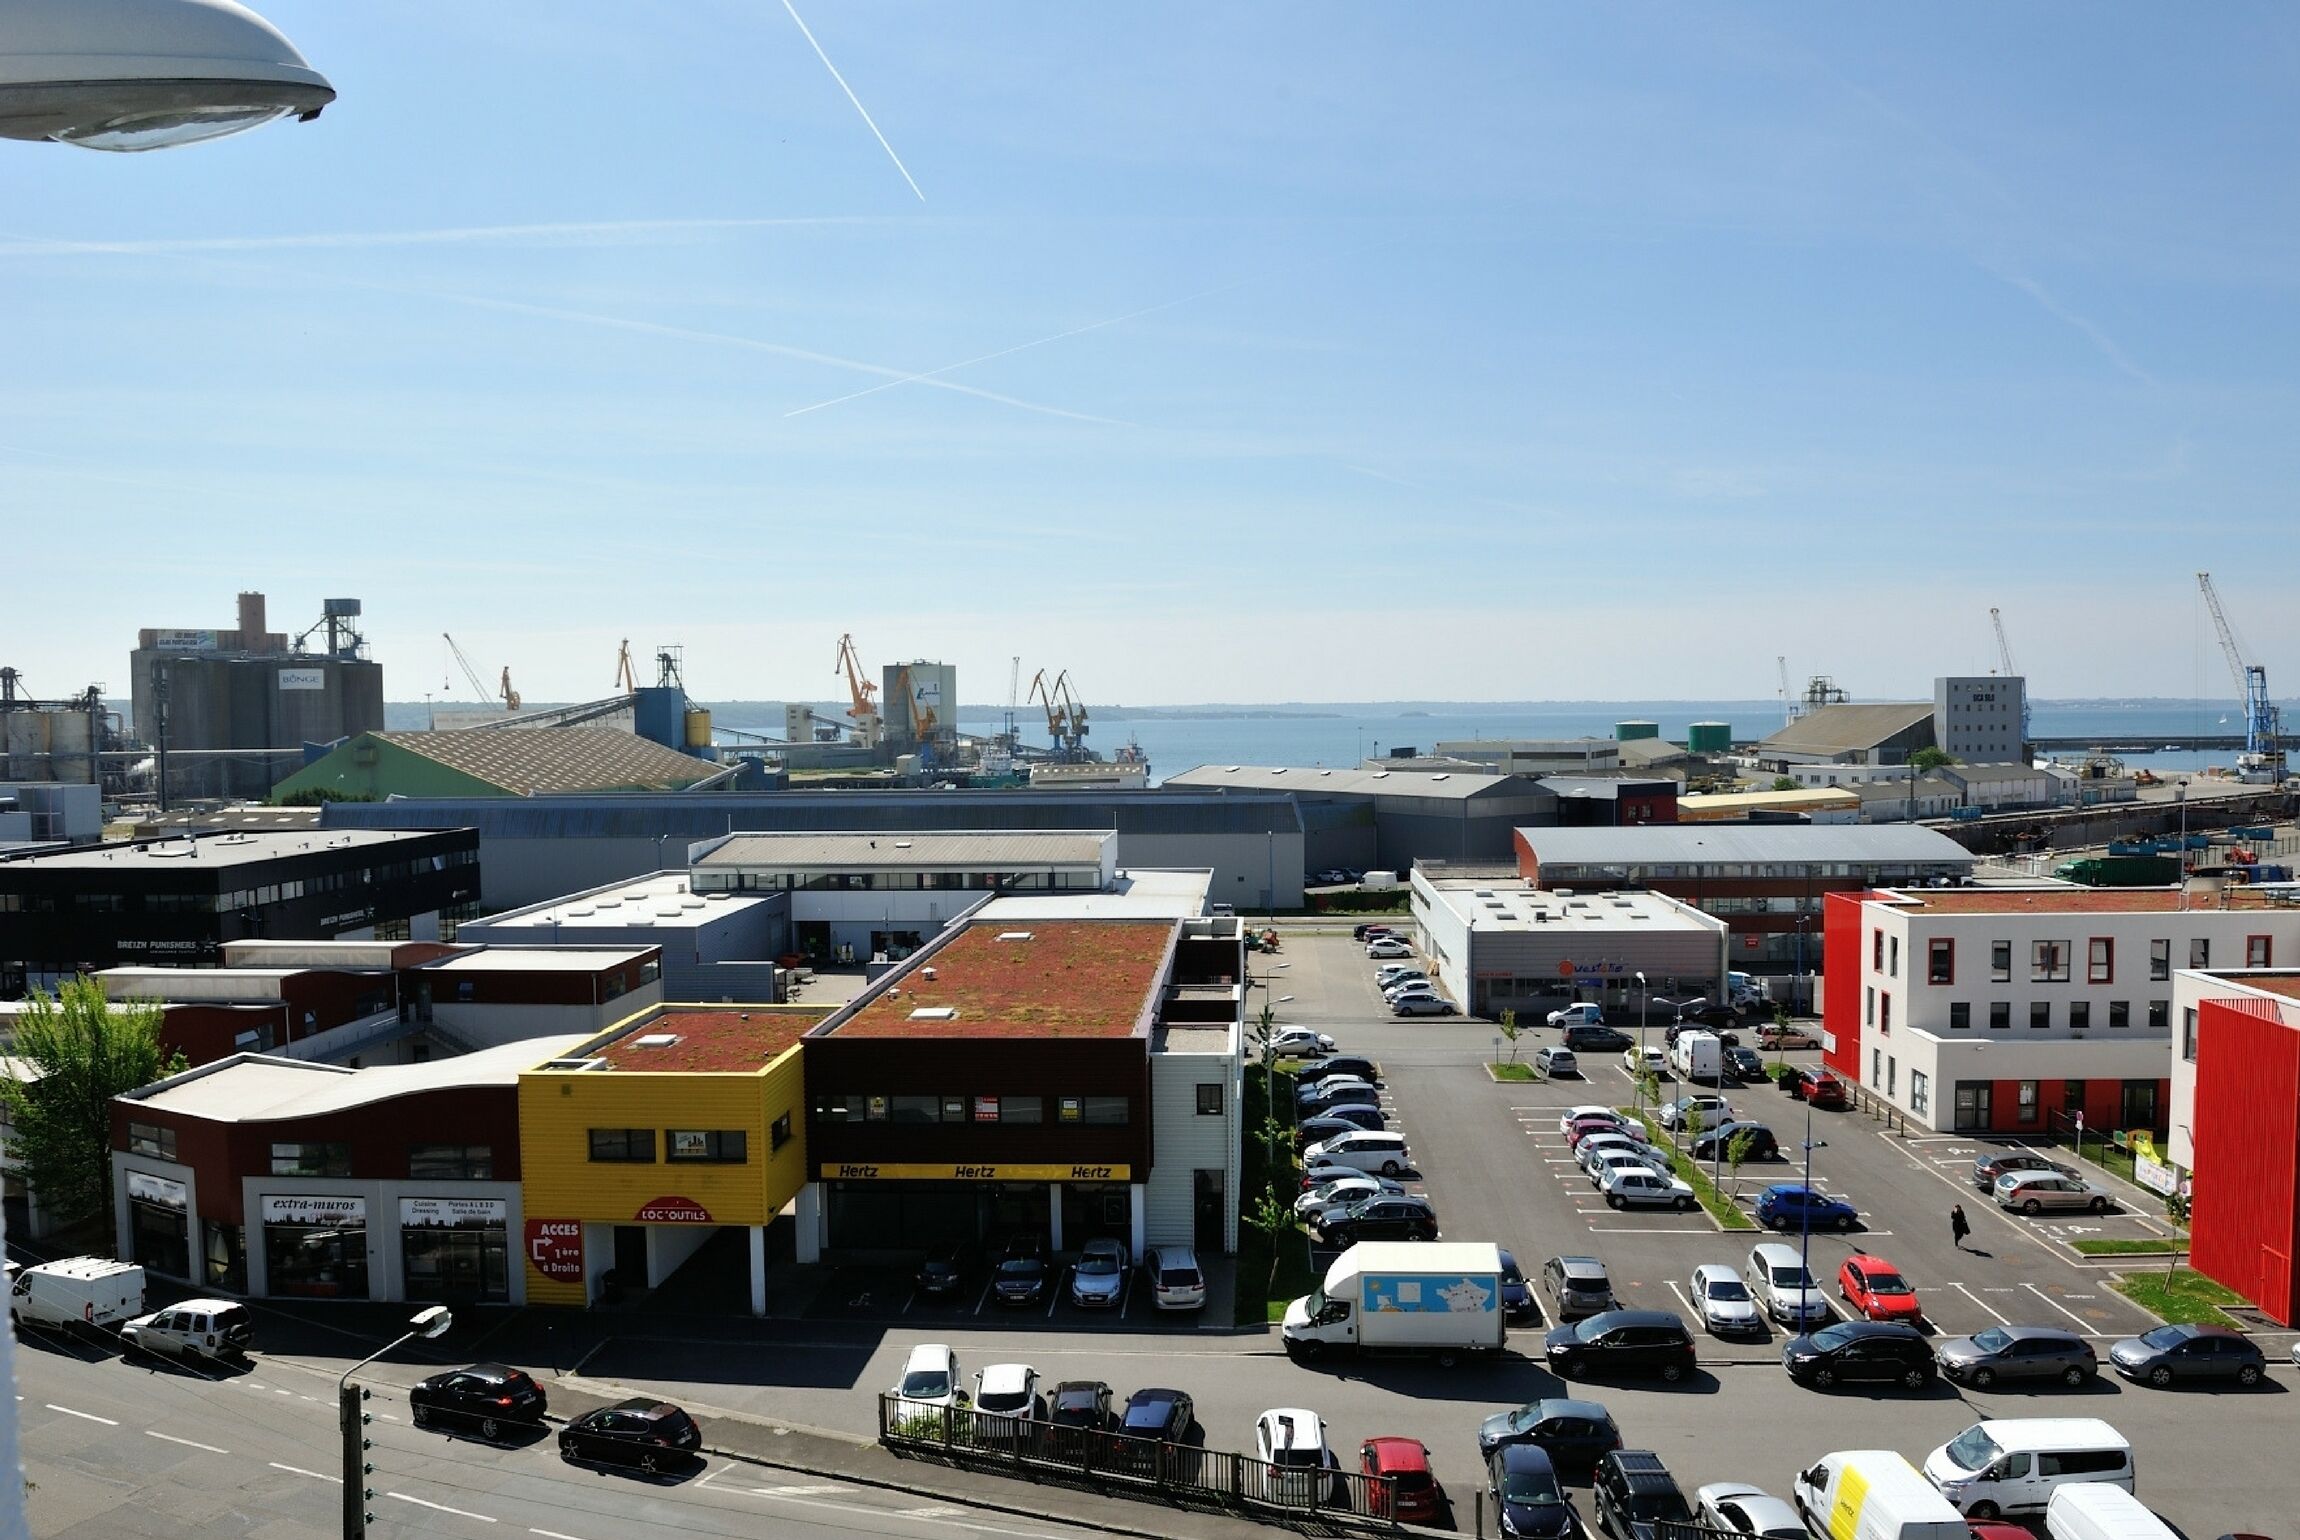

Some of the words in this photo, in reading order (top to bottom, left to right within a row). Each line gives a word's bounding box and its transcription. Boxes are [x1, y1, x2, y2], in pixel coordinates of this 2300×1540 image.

[282, 675, 320, 683] BUNGE
[149, 940, 197, 949] PUNISHERS
[839, 1165, 879, 1177] Hertz
[955, 1165, 996, 1178] Hertz
[1071, 1166, 1113, 1178] Hertz
[273, 1199, 356, 1211] extra-muros
[413, 1200, 437, 1208] Cuisine
[411, 1207, 440, 1215] Dressing
[541, 1223, 579, 1236] ACCES
[543, 1261, 549, 1272] à
[551, 1262, 580, 1273] Droite
